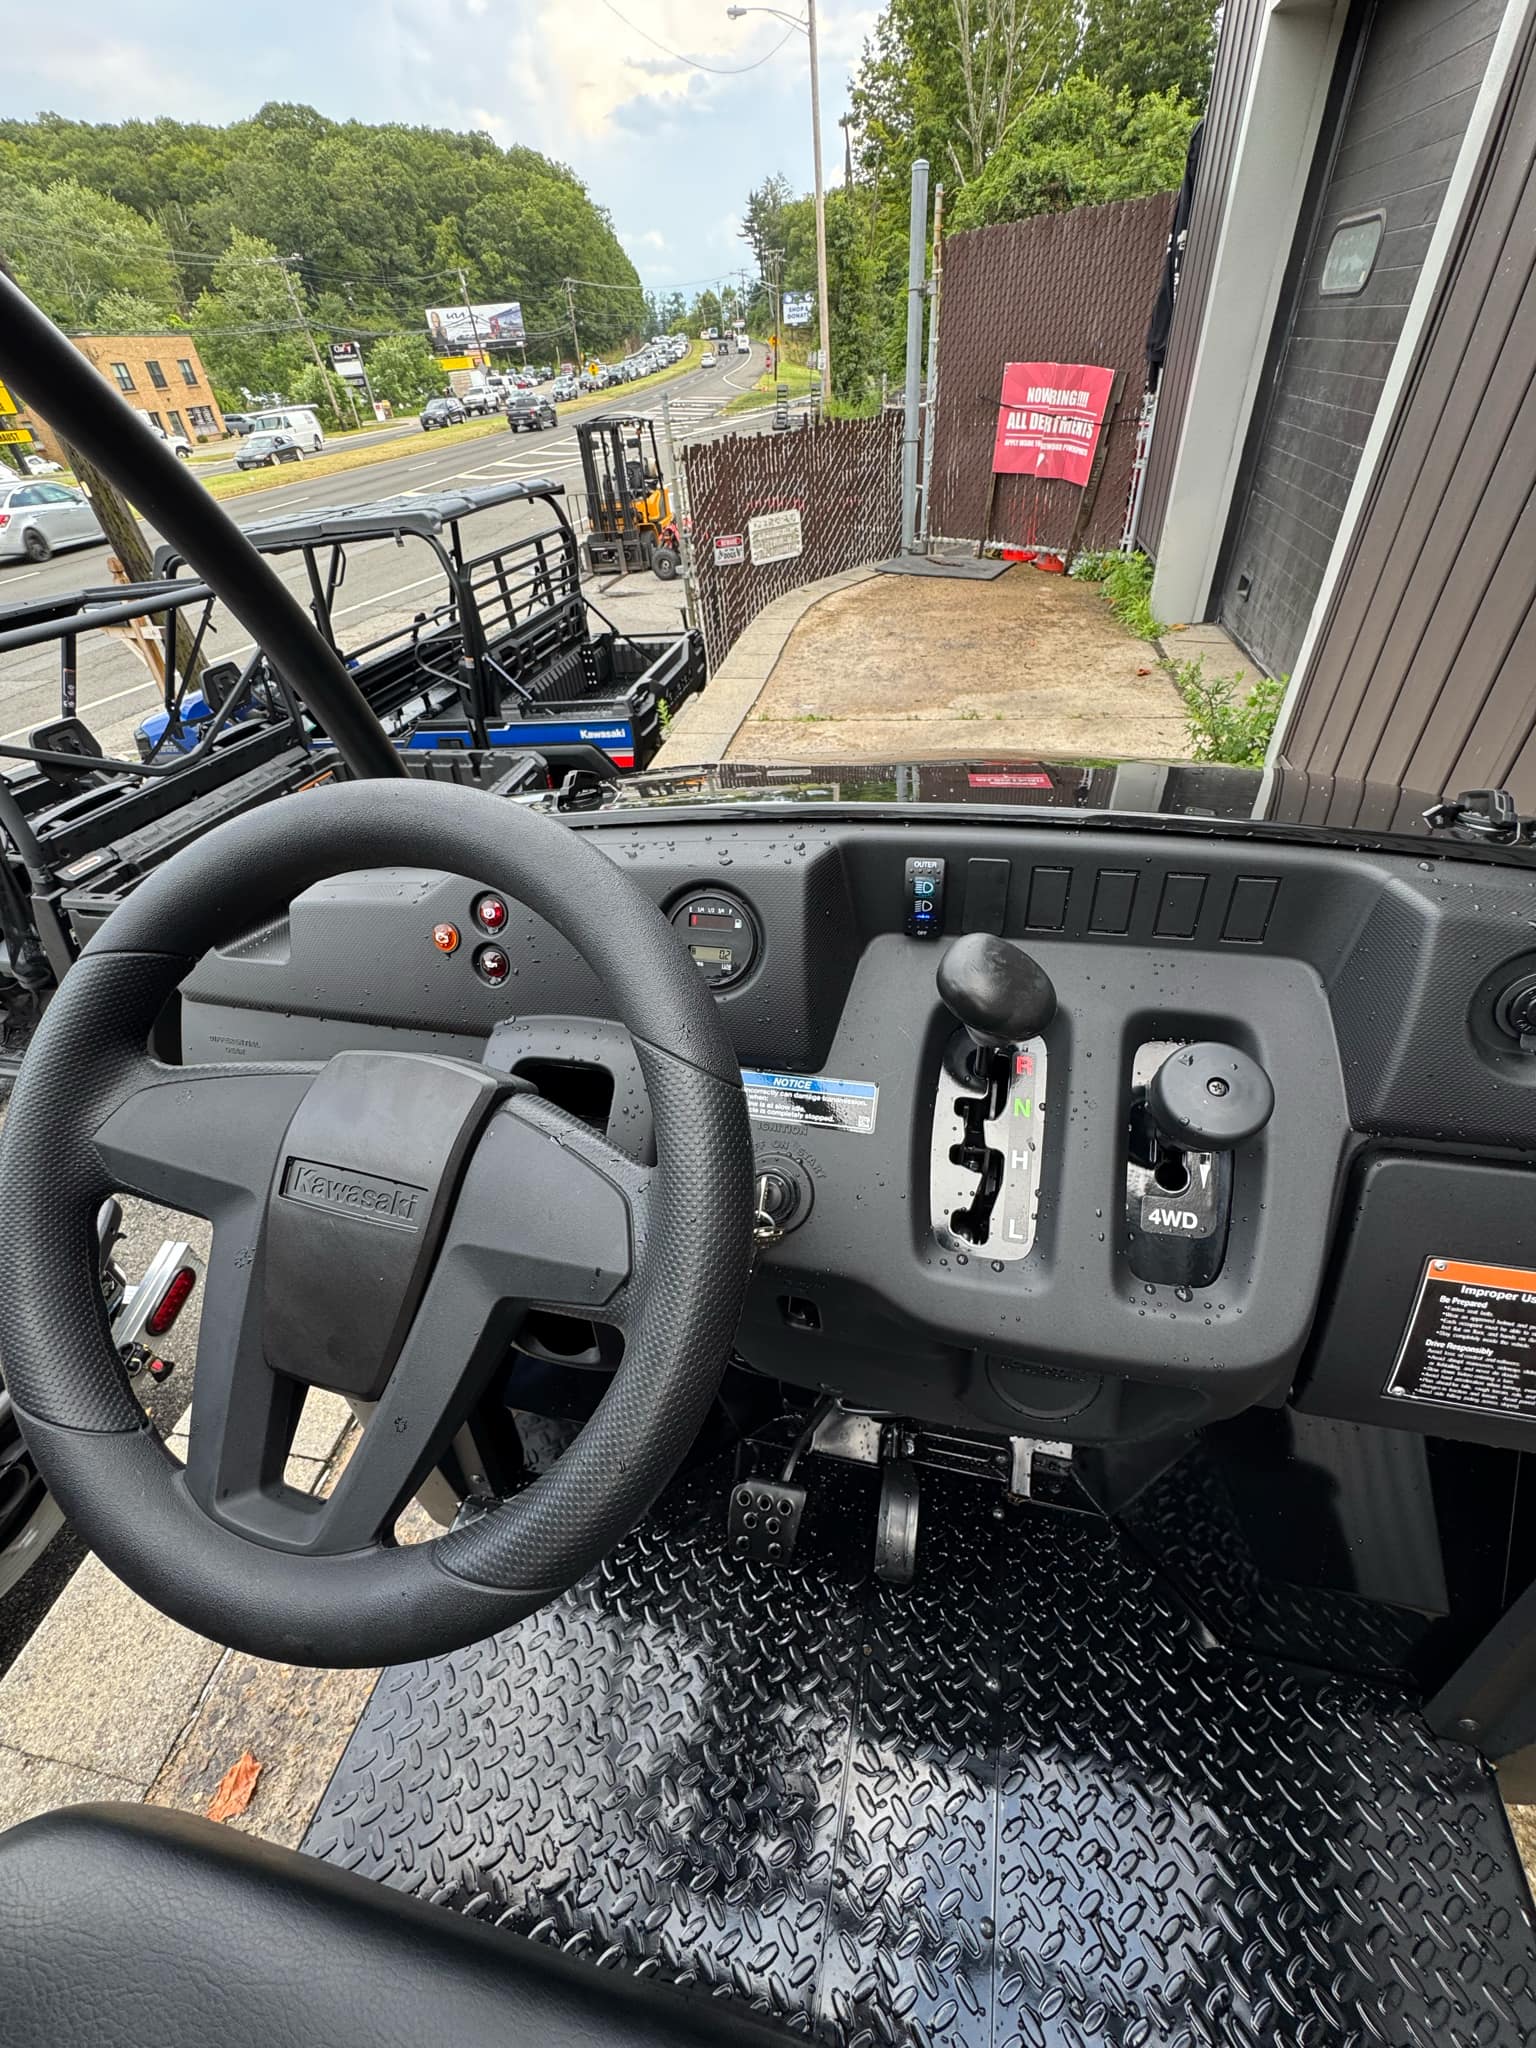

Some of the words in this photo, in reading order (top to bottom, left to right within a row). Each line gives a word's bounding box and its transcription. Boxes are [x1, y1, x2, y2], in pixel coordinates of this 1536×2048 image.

[1006, 412, 1027, 430] ALL
[580, 728, 626, 739] Kawasaki
[1016, 1056, 1034, 1076] R
[773, 1077, 812, 1090] NOTICE
[1014, 1098, 1032, 1118] N
[1011, 1150, 1028, 1170] H
[294, 1166, 419, 1221] Kawasaki
[1148, 1208, 1198, 1230] 4WD
[1008, 1219, 1024, 1240] L
[1440, 1295, 1450, 1303] Be
[1452, 1297, 1488, 1309] Prepared
[1460, 1285, 1518, 1300] Improper
[1425, 1339, 1446, 1349] Drive
[1446, 1342, 1494, 1356] Responsibly
